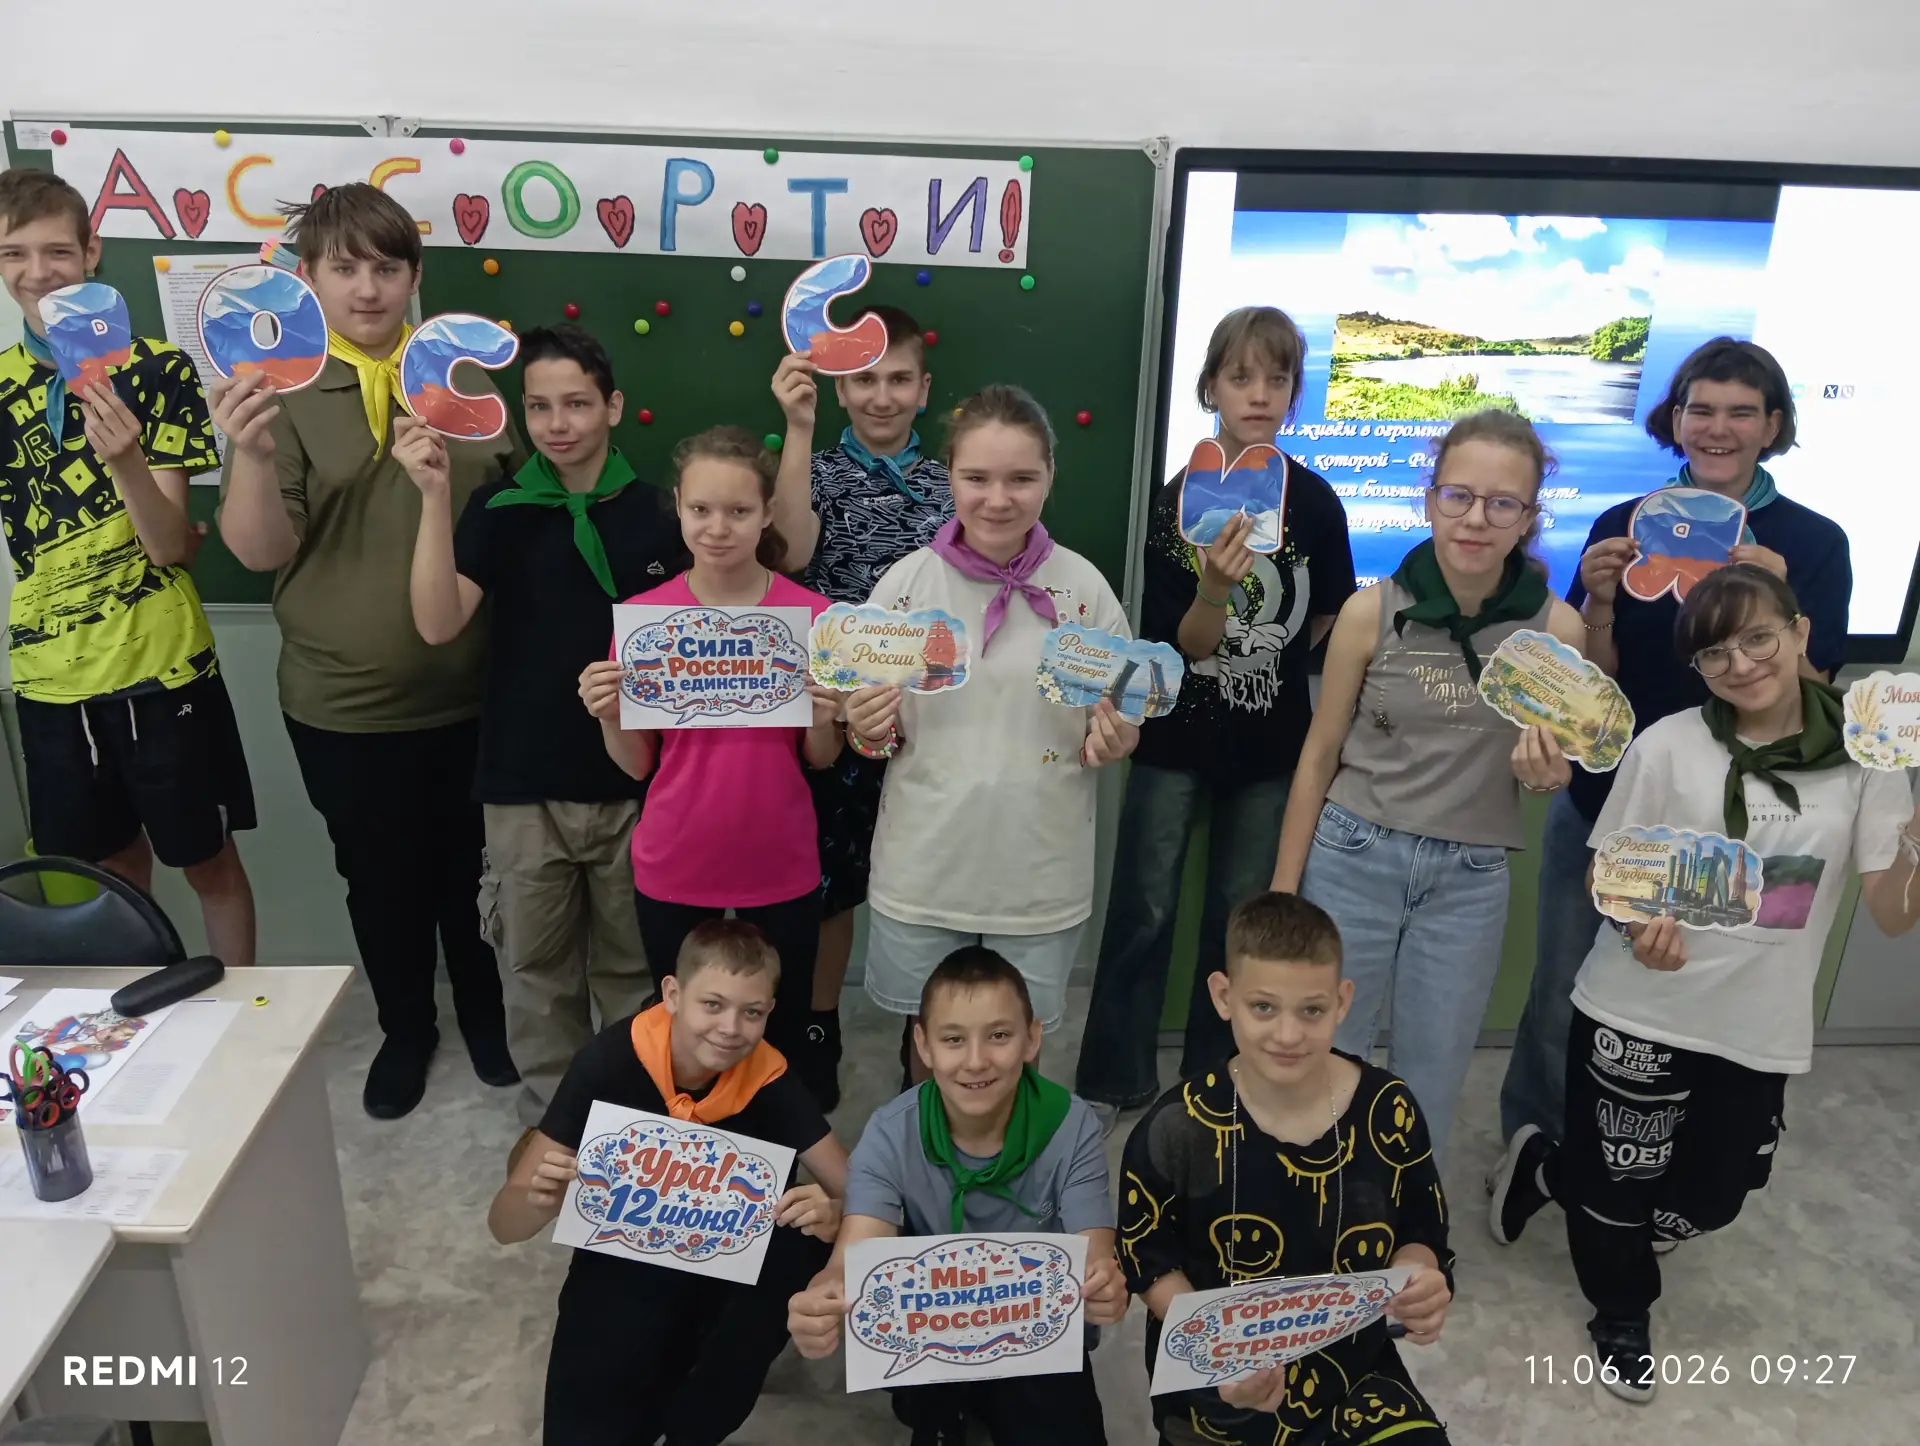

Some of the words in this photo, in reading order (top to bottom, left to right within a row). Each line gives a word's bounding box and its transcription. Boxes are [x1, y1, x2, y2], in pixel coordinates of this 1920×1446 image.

[1314, 451, 1390, 472] которой
[1361, 479, 1426, 498] больша
[840, 614, 857, 634] С
[859, 621, 925, 638] любовью
[677, 636, 754, 659] Сила
[852, 642, 916, 666] России
[879, 640, 889, 649] к
[668, 656, 764, 678] России
[1067, 662, 1108, 678] горжусь
[664, 680, 676, 693] в
[680, 672, 777, 692] единстве!
[1510, 670, 1561, 709] Россия
[1528, 670, 1566, 696] любимая
[1752, 814, 1798, 823] ARTIST
[1610, 836, 1671, 854] Россия
[1615, 857, 1665, 867] смотрит
[1604, 866, 1613, 878] в
[1616, 866, 1668, 883] будущее
[1624, 1049, 1655, 1062] STEP
[1657, 1053, 1672, 1063] UP
[1626, 1040, 1653, 1053] ONE
[1623, 1058, 1660, 1072] LEVEL
[632, 1147, 738, 1197] Ура!
[605, 1183, 658, 1227] 12
[656, 1203, 757, 1237] июня!
[931, 1266, 986, 1290] Мы
[900, 1279, 1043, 1311] граждане
[906, 1297, 1042, 1335] России!
[1221, 1291, 1356, 1326] Горжусь
[1242, 1307, 1330, 1338] своей
